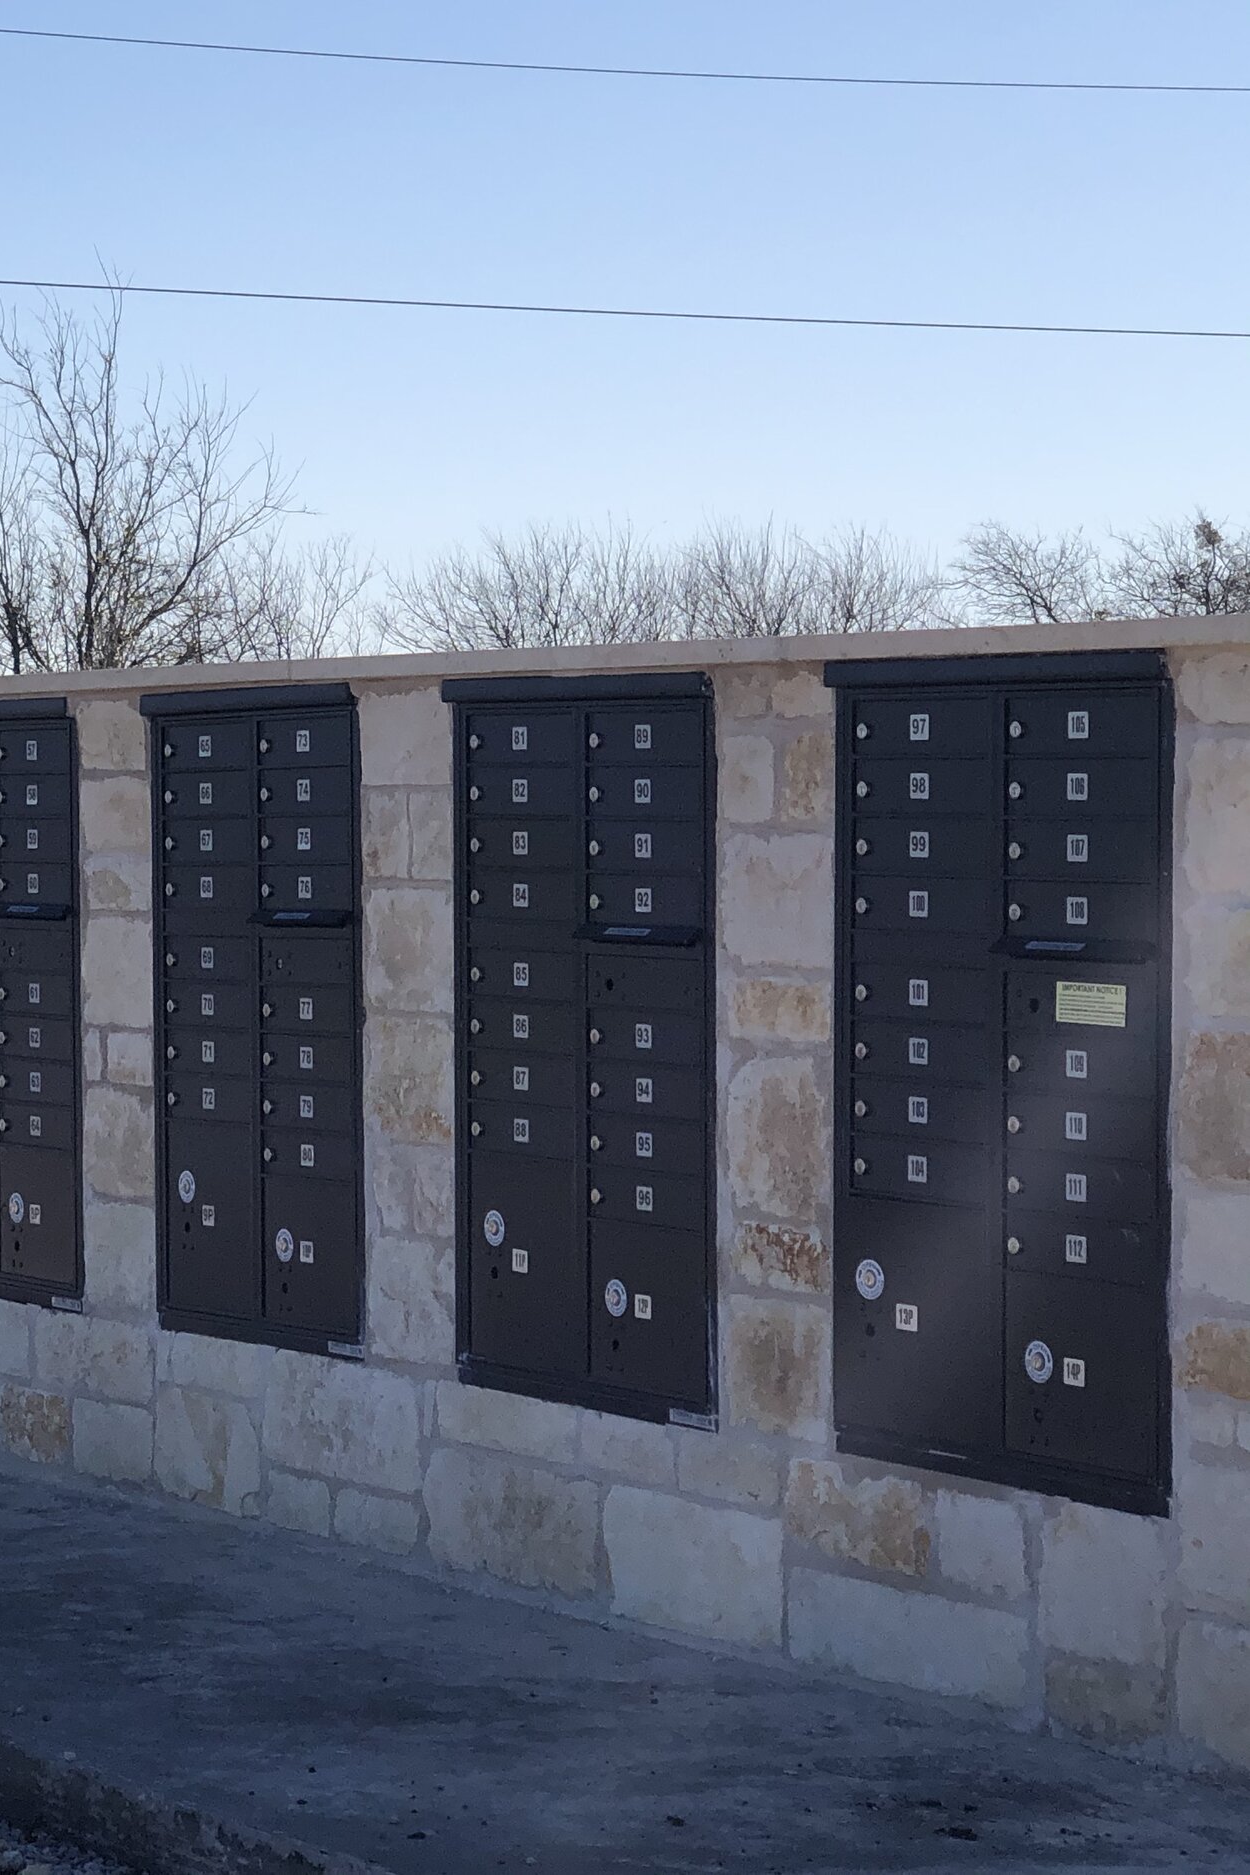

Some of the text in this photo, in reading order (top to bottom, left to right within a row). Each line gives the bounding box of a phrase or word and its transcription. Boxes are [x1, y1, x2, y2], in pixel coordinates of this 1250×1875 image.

[911, 717, 928, 736] 97
[1069, 714, 1087, 735] 105
[298, 732, 308, 749] 73
[513, 730, 526, 747] 81
[636, 728, 650, 745] 89
[28, 743, 36, 757] 57
[200, 738, 210, 754] 65
[201, 785, 211, 801] 66
[298, 781, 309, 798] 74
[514, 782, 526, 799] 82
[636, 782, 650, 799] 90
[911, 776, 928, 795] 98
[1068, 776, 1087, 796] 106
[28, 787, 36, 802] 58
[28, 831, 37, 846] 59
[201, 832, 211, 847] 67
[298, 830, 309, 847] 75
[514, 834, 527, 851] 83
[636, 837, 650, 854] 91
[911, 834, 928, 854] 99
[1068, 838, 1087, 858] 107
[202, 879, 212, 895] 68
[299, 879, 310, 895] 76
[514, 887, 527, 904] 84
[636, 891, 650, 908] 92
[910, 894, 927, 913] 100
[1068, 900, 1086, 920] 108
[202, 949, 212, 965] 69
[515, 966, 527, 983] 85
[30, 985, 38, 1000] 61
[910, 982, 927, 1002] 101
[1061, 983, 1095, 993] IMPORTANT
[1096, 985, 1118, 995] NOTICE
[203, 996, 213, 1012] 70
[301, 1000, 311, 1016] 77
[514, 1017, 527, 1034] 86
[30, 1030, 39, 1044] 62
[637, 1027, 651, 1044] 93
[203, 1043, 213, 1059] 71
[301, 1049, 312, 1066] 78
[910, 1041, 927, 1060] 102
[1067, 1053, 1086, 1074] 109
[31, 1074, 40, 1089] 63
[515, 1069, 527, 1086] 87
[204, 1090, 214, 1106] 72
[637, 1081, 651, 1099] 94
[301, 1098, 312, 1115] 79
[910, 1099, 926, 1119] 103
[31, 1118, 40, 1133] 64
[515, 1121, 528, 1139] 88
[1067, 1115, 1085, 1136] 110
[637, 1135, 651, 1153] 95
[302, 1146, 313, 1163] 80
[909, 1158, 926, 1179] 104
[1067, 1177, 1085, 1198] 111
[637, 1189, 652, 1207] 96
[203, 1207, 214, 1223] 9P
[1067, 1238, 1086, 1259] 112
[513, 1251, 527, 1269] 11P
[636, 1297, 650, 1315] 12P
[897, 1307, 917, 1327] 13P
[1064, 1360, 1084, 1382] 14P
